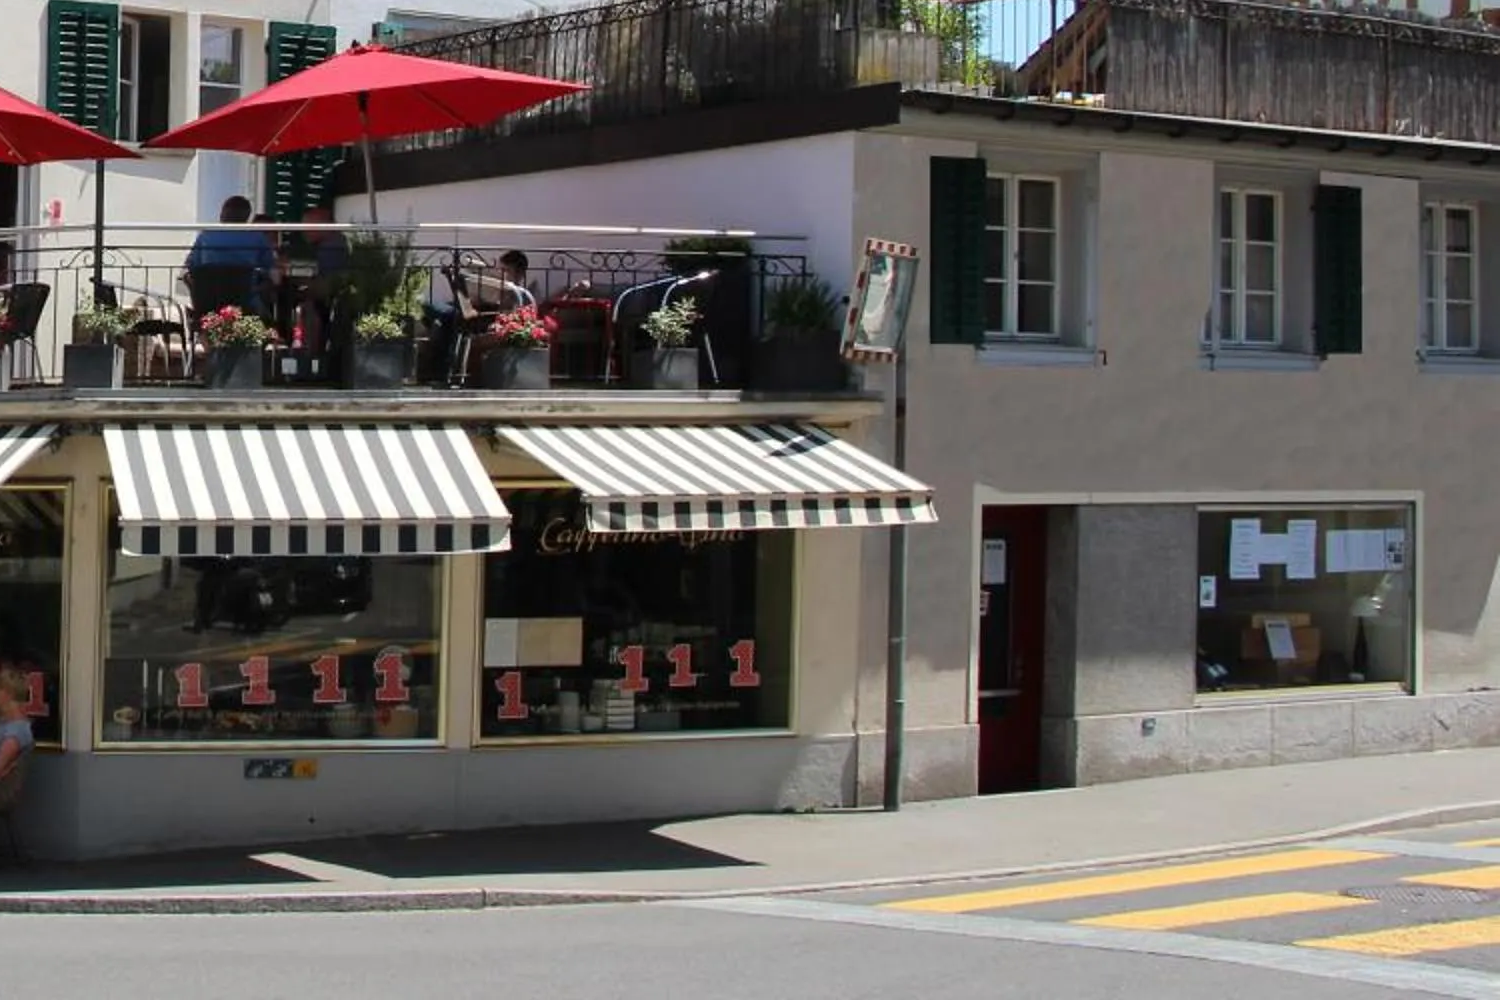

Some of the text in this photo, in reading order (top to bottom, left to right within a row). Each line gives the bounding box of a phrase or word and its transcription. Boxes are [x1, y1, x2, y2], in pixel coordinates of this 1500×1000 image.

[174, 653, 410, 708] 1 1 1 1
[495, 639, 761, 720] 1 1 1 1
